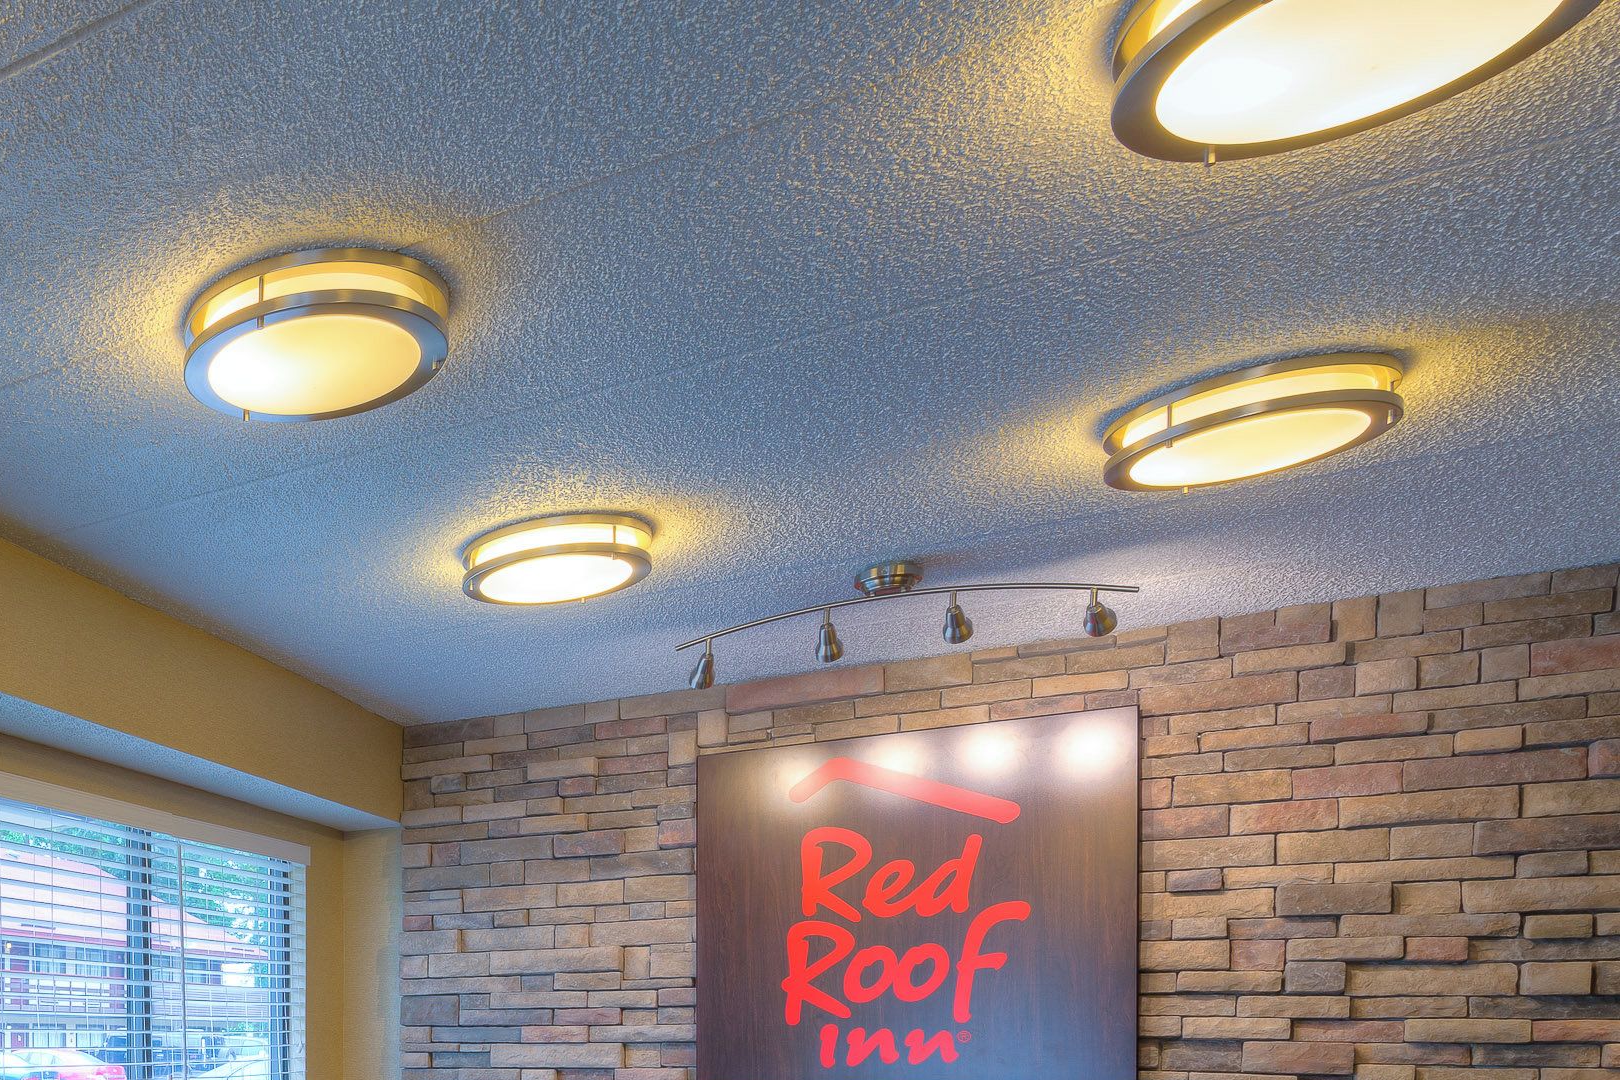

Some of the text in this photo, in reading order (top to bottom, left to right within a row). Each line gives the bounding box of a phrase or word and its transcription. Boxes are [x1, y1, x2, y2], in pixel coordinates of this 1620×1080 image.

[800, 826, 983, 923] Red
[781, 900, 1031, 1026] Roof
[818, 1023, 960, 1068] inn
